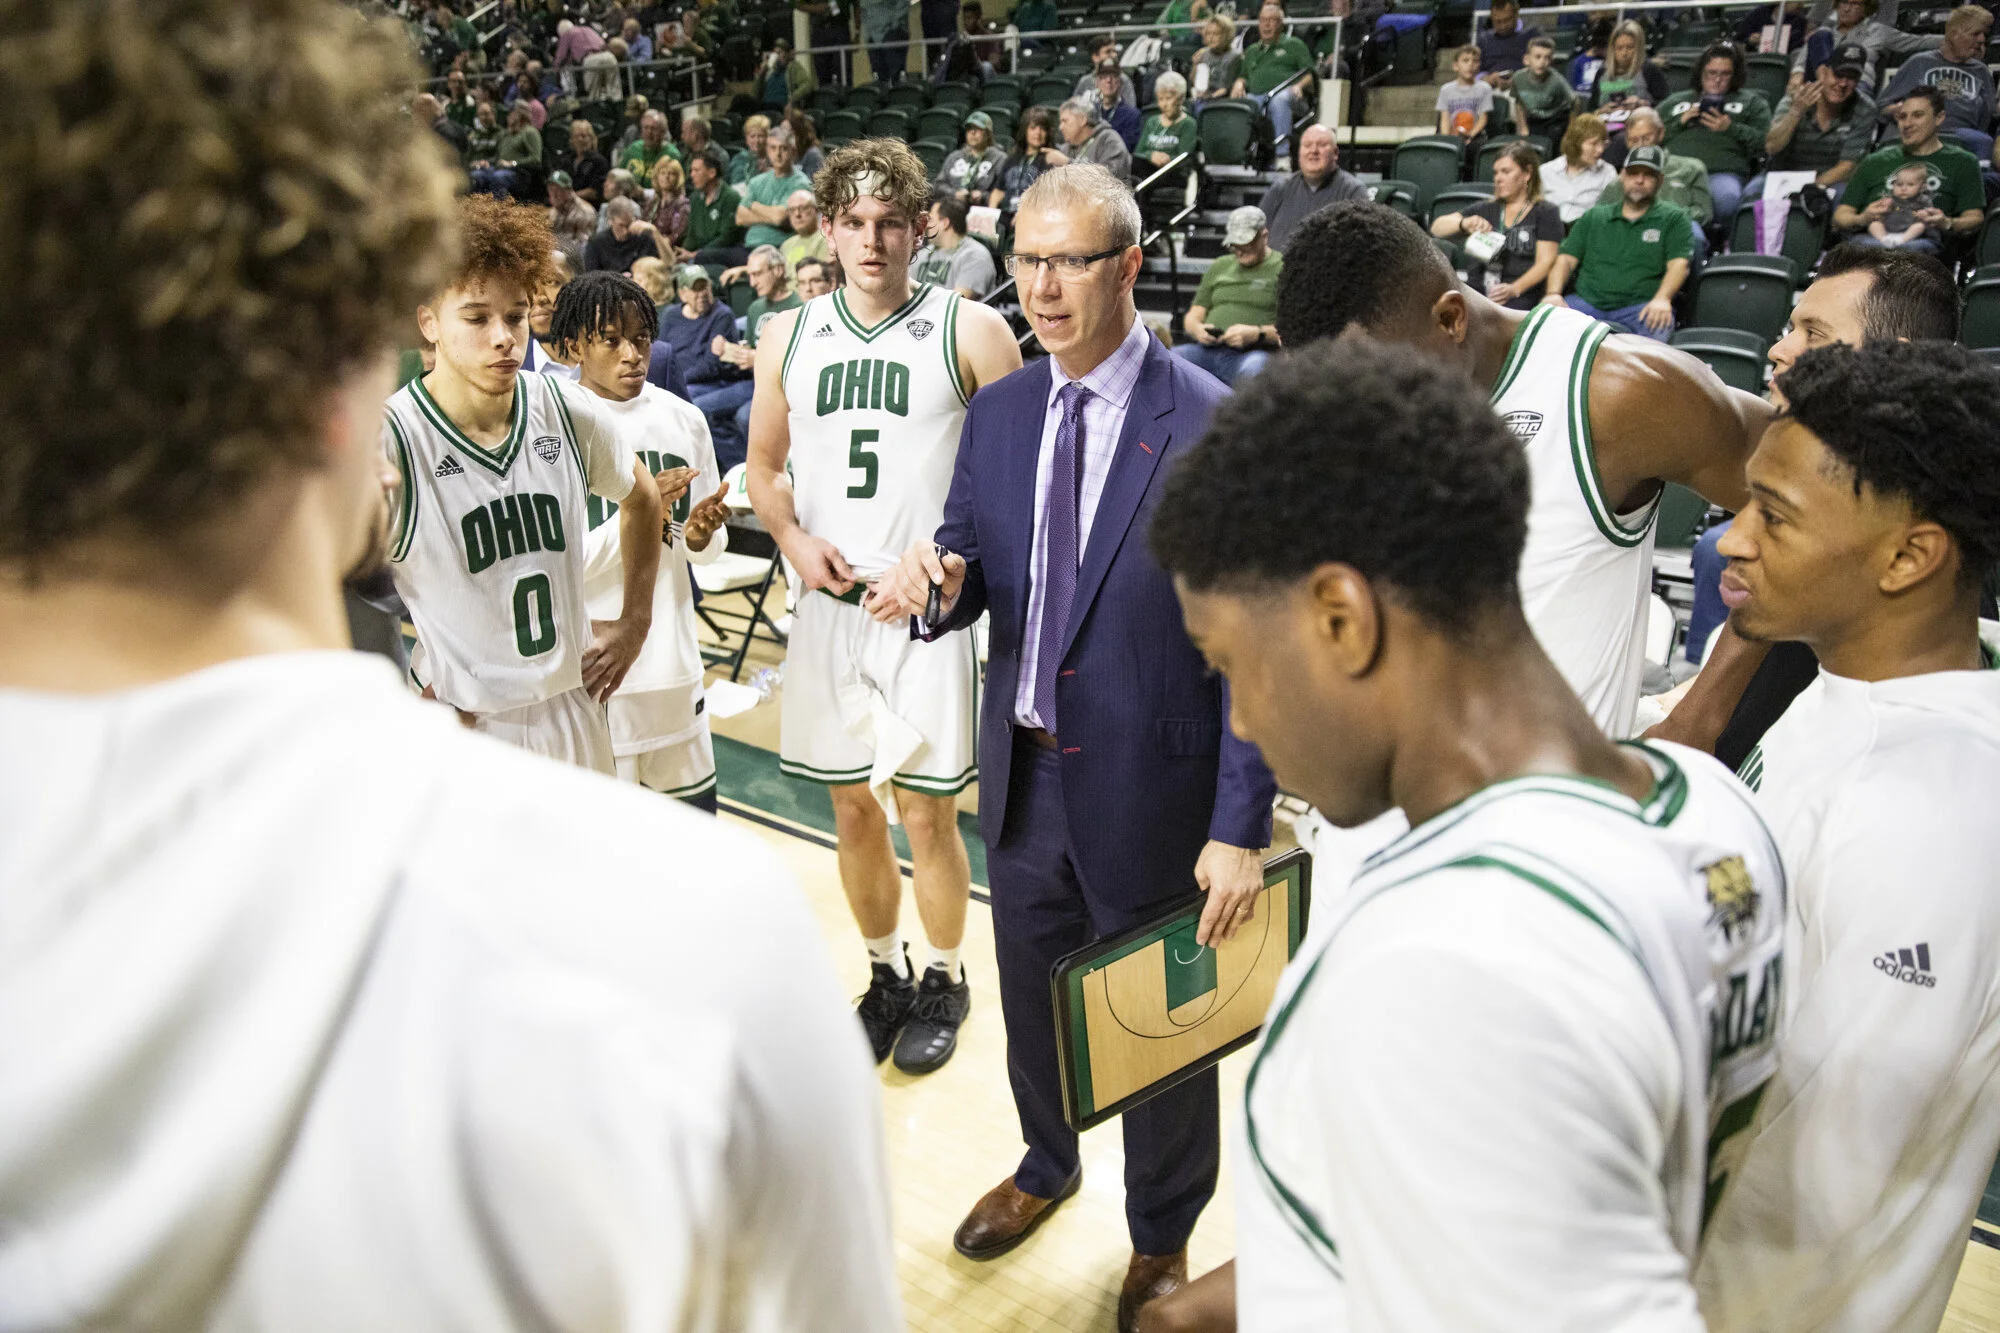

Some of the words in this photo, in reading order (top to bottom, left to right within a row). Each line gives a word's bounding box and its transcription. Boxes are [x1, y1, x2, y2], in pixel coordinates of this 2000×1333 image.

[816, 359, 910, 417] OHIO
[537, 442, 560, 455] MAC
[846, 429, 880, 499] 5
[435, 466, 464, 477] adidas
[461, 493, 566, 574] OHIO
[1873, 956, 1936, 988] adidas
